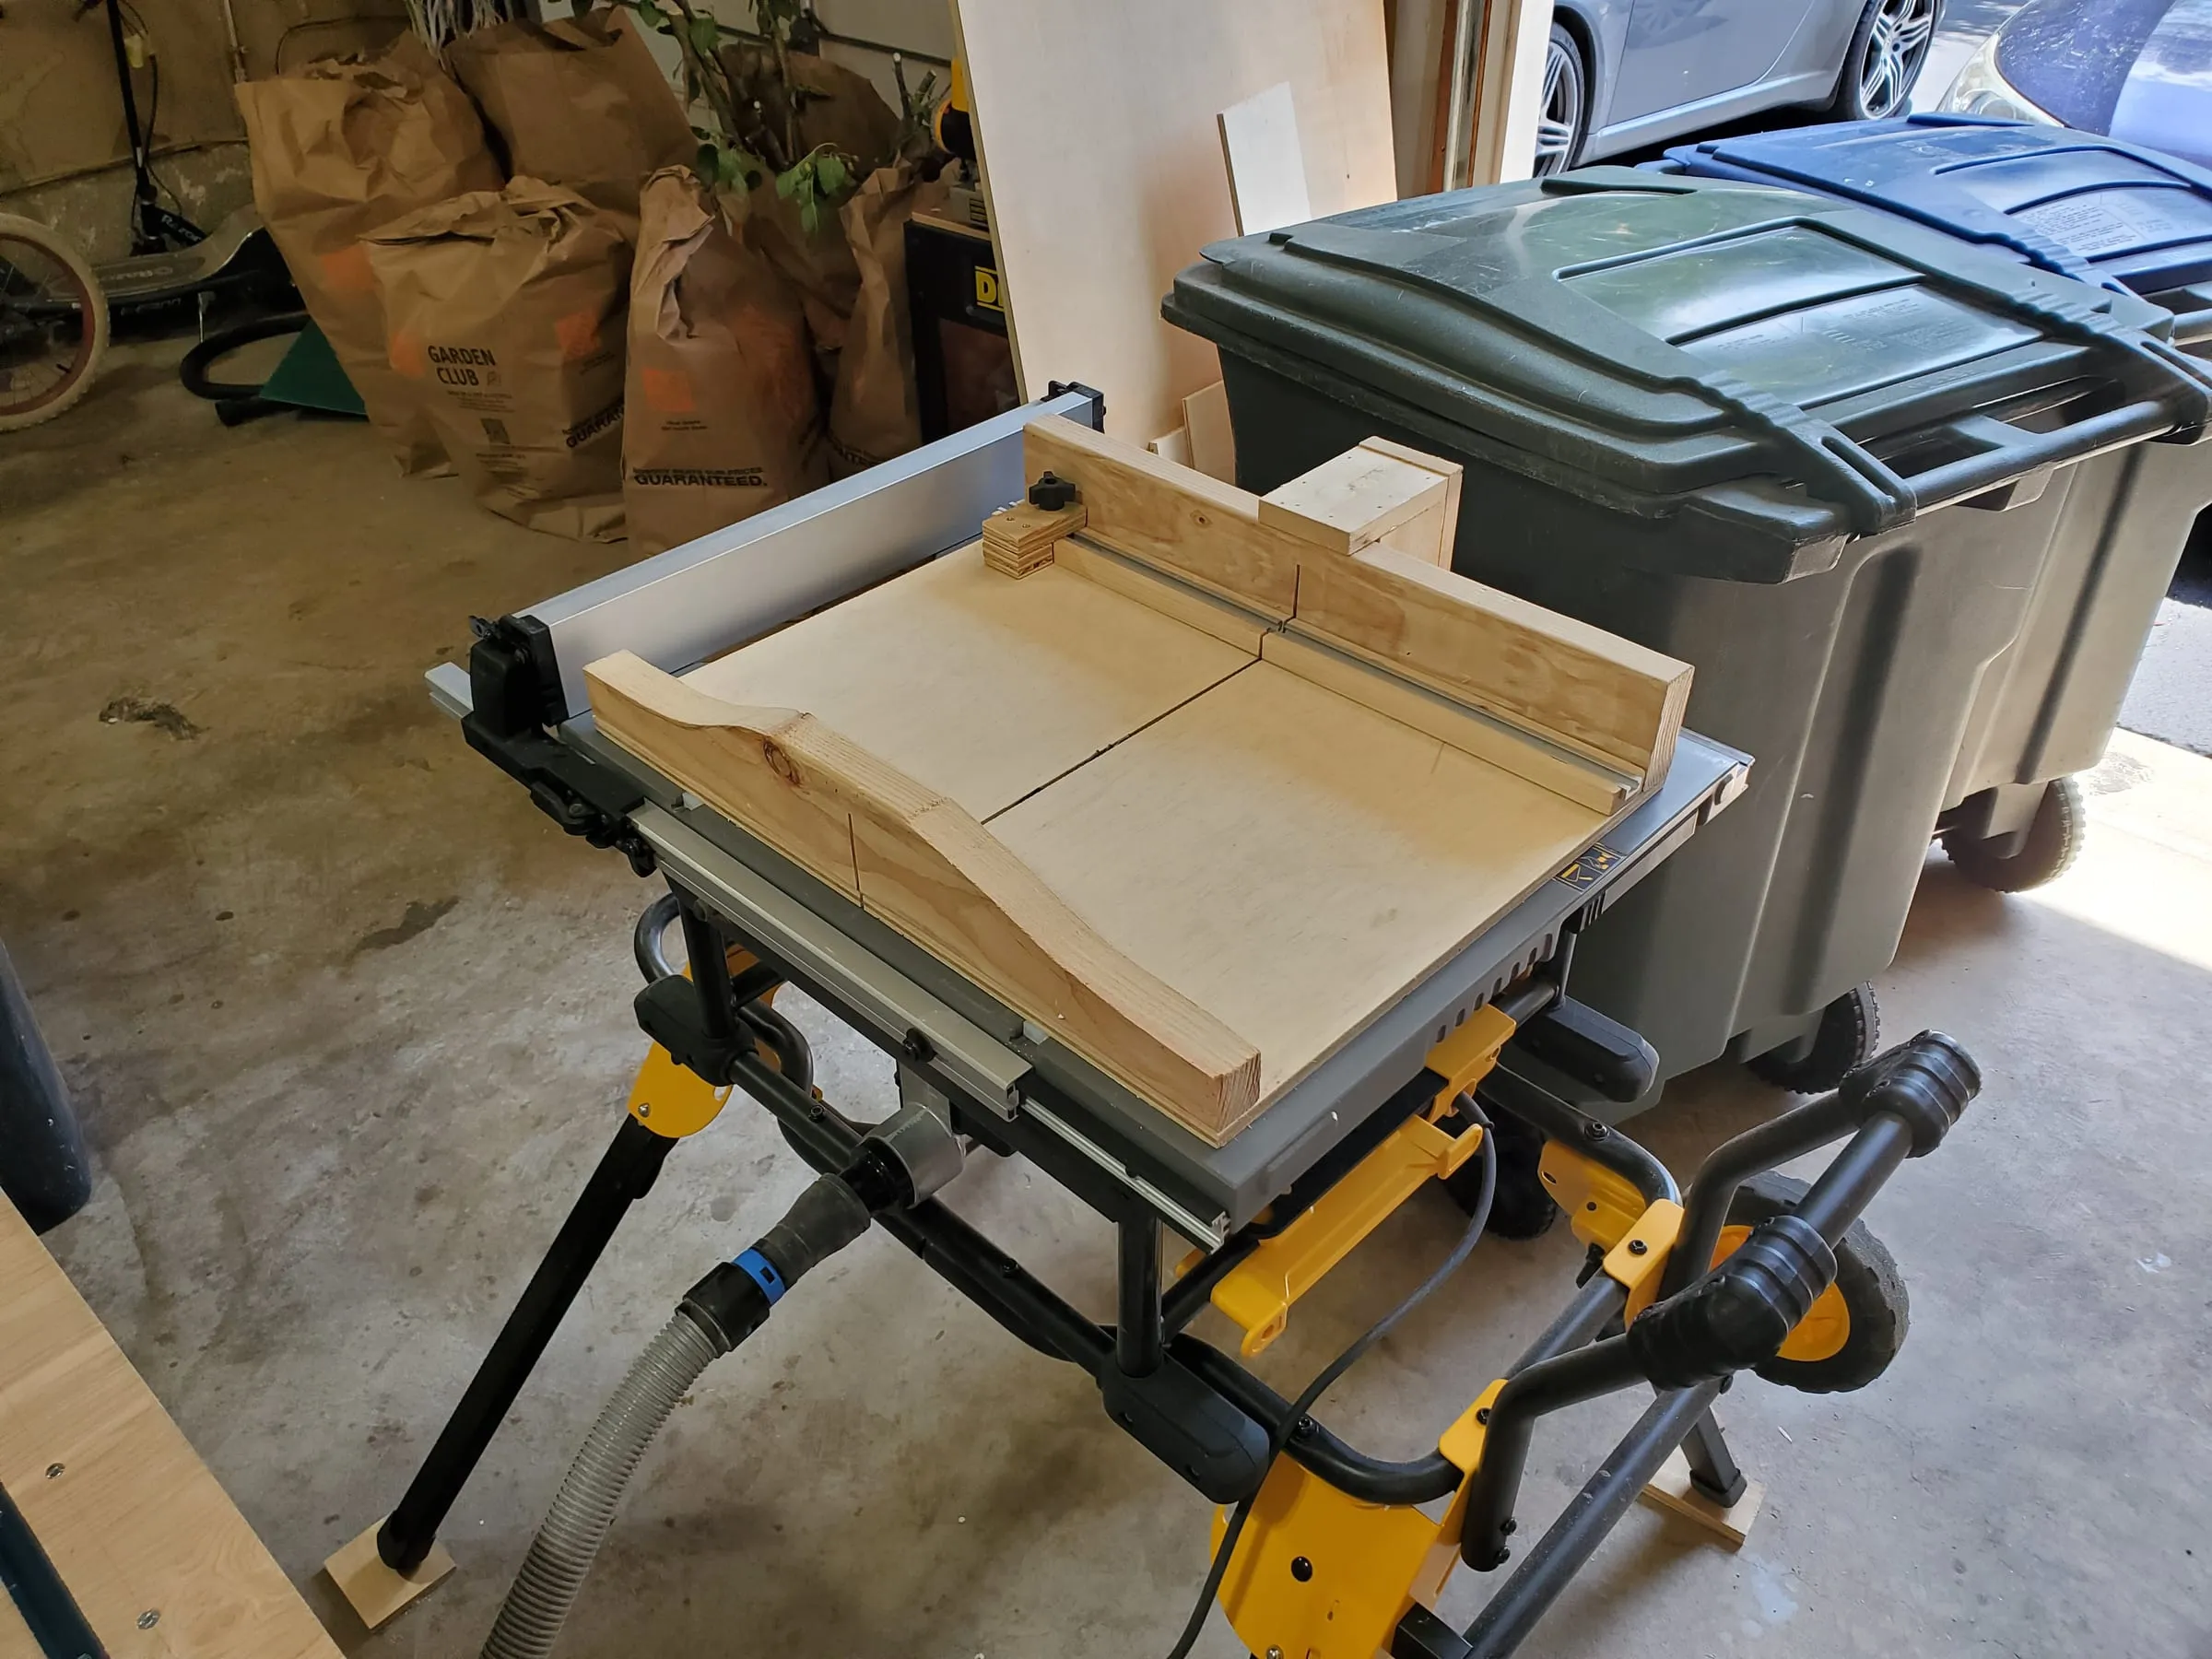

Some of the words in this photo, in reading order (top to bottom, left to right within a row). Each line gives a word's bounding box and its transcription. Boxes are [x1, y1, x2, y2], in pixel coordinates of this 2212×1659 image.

[428, 345, 497, 367] GARDEN
[436, 368, 479, 386] CLUB
[633, 475, 768, 487] GUARANTEED.
